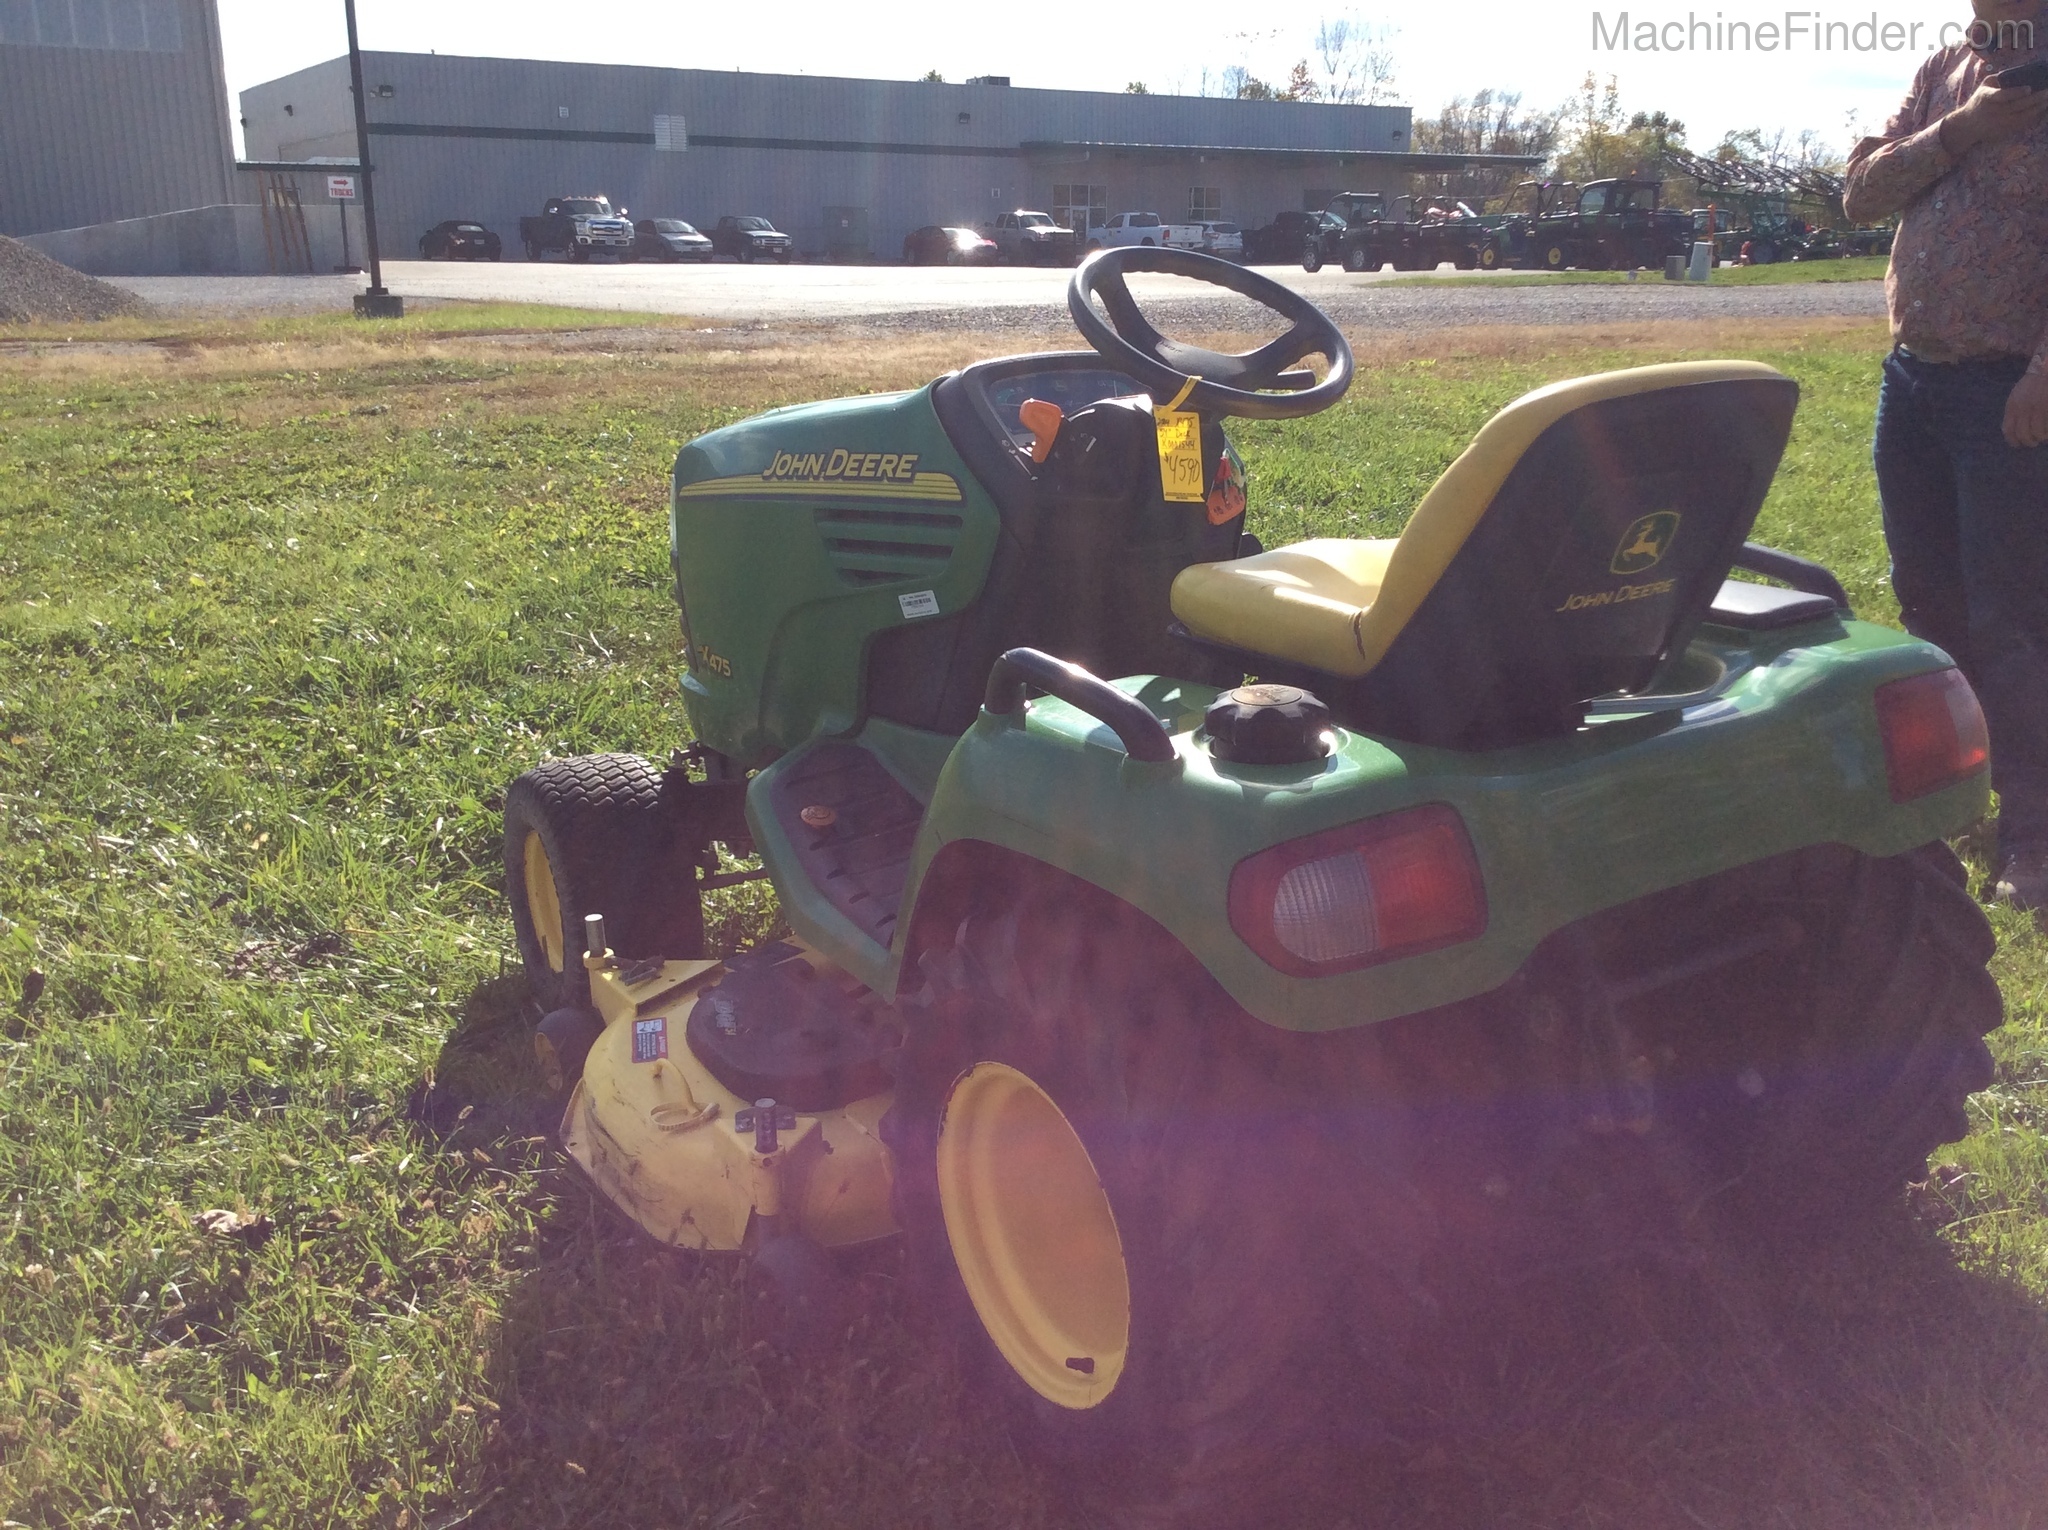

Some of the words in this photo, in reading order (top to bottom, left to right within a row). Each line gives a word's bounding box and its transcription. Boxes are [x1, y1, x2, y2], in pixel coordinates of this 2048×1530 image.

[763, 449, 825, 479] JOHN
[820, 448, 919, 481] DEERE
[1556, 591, 1615, 612] JOHN
[1613, 578, 1677, 603] DEERE
